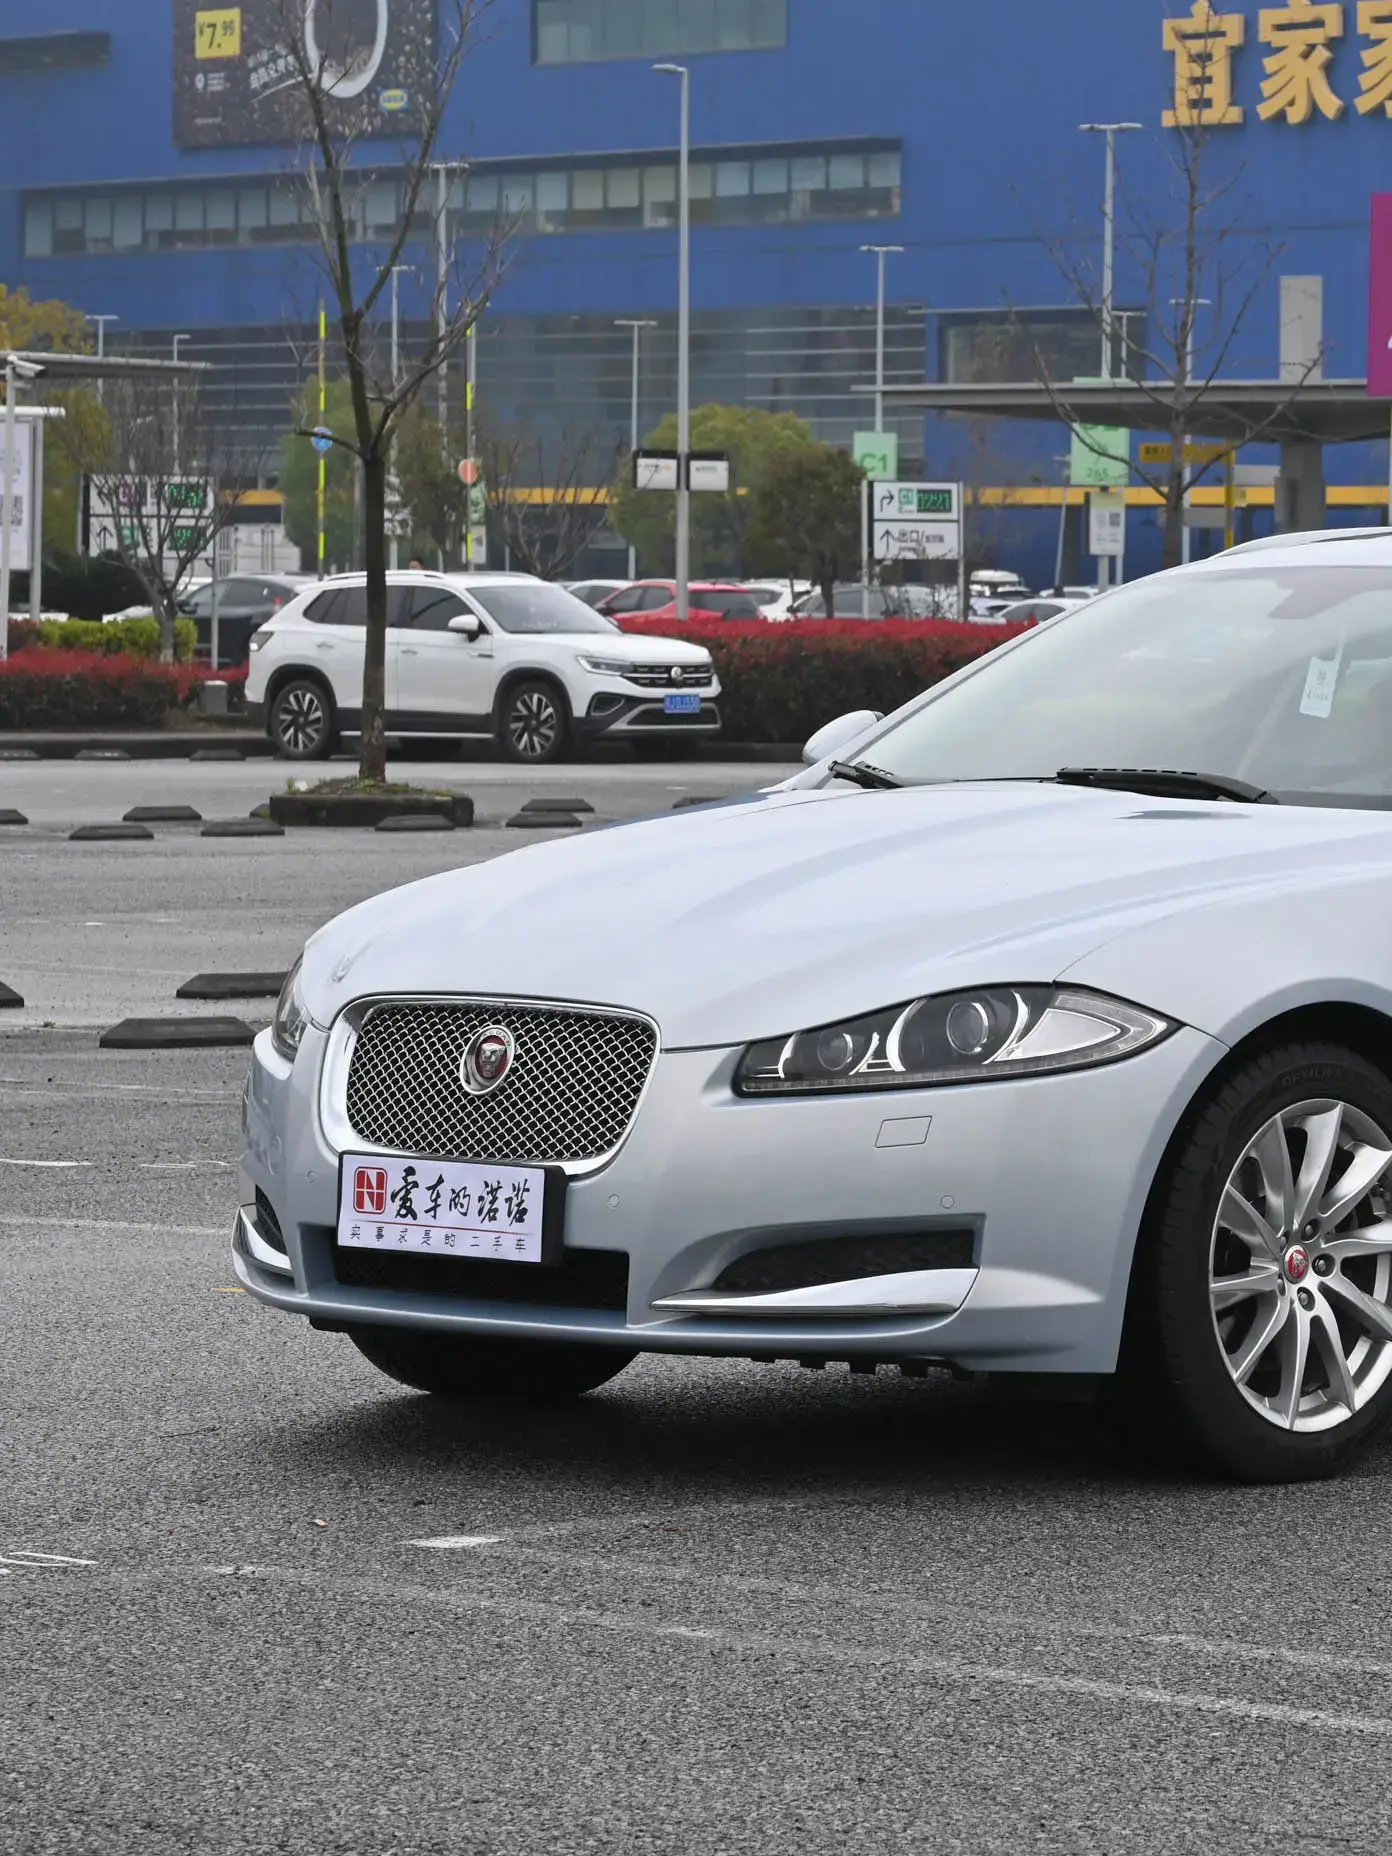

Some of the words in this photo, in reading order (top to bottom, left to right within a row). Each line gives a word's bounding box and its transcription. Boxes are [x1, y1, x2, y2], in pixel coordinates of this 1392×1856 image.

[860, 453, 887, 474] C1
[350, 1223, 527, 1253] 实事求是的二手车
